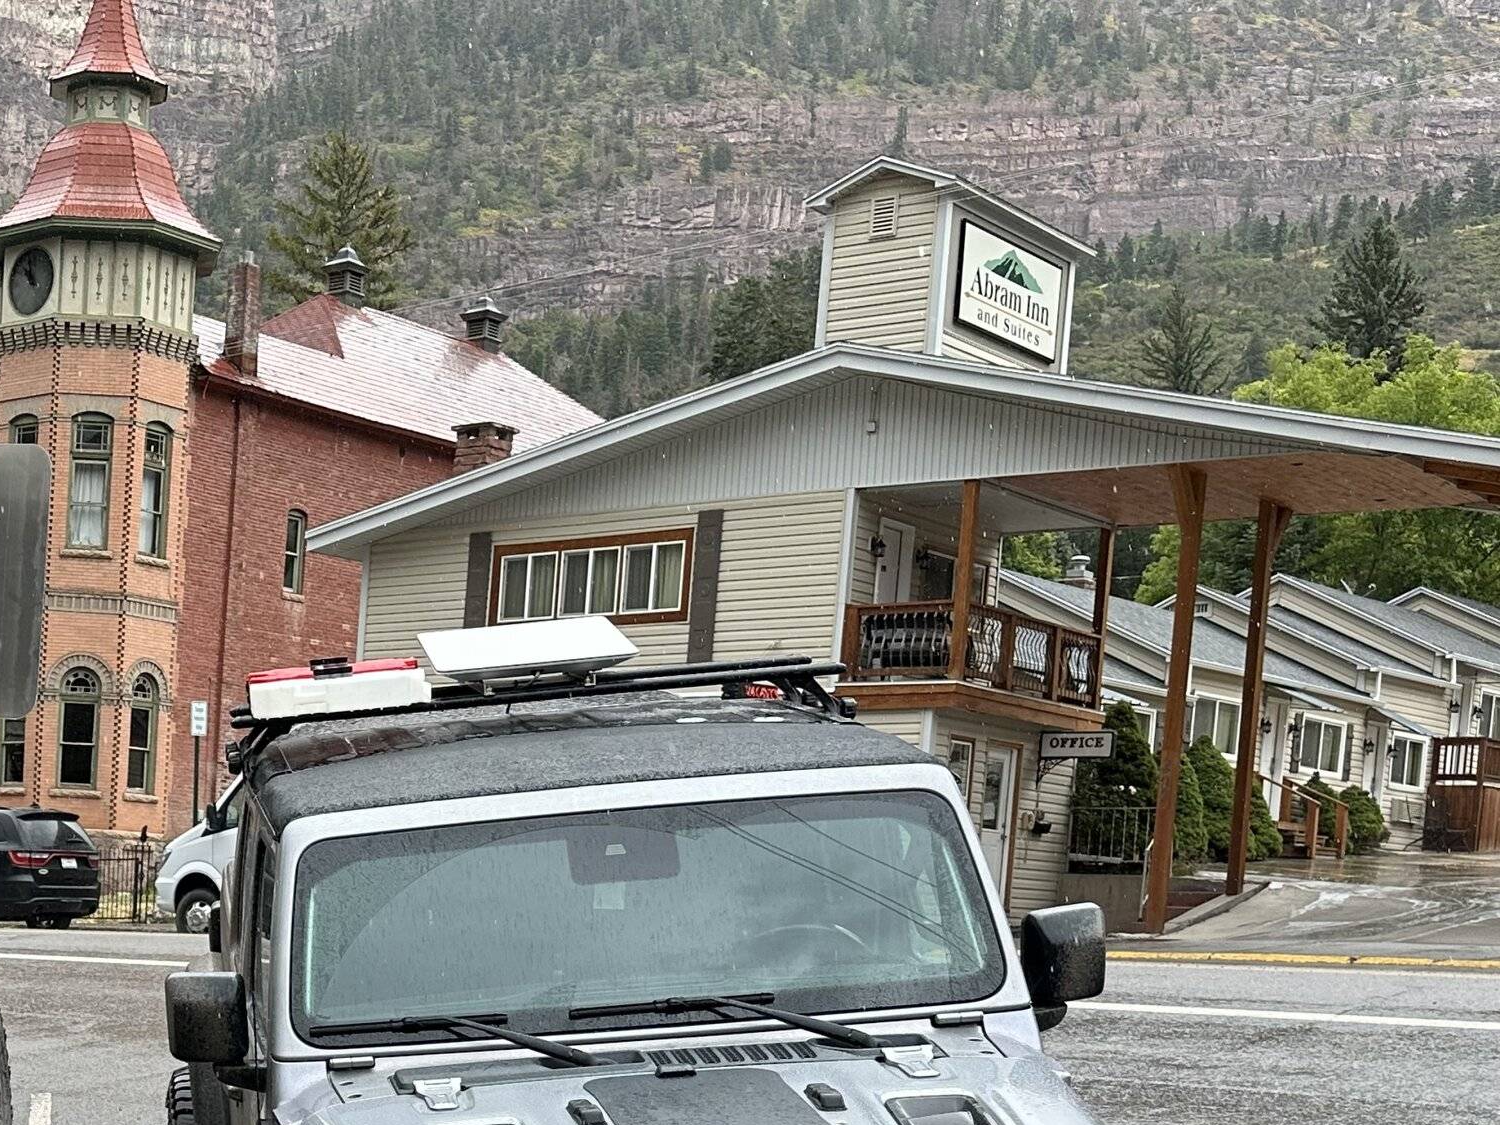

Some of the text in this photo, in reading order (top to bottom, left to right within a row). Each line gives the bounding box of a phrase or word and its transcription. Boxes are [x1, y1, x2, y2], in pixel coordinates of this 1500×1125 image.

[970, 267, 1049, 326] Abram Inn
[977, 308, 1040, 346] and Suites
[1049, 736, 1105, 748] OFFICE
